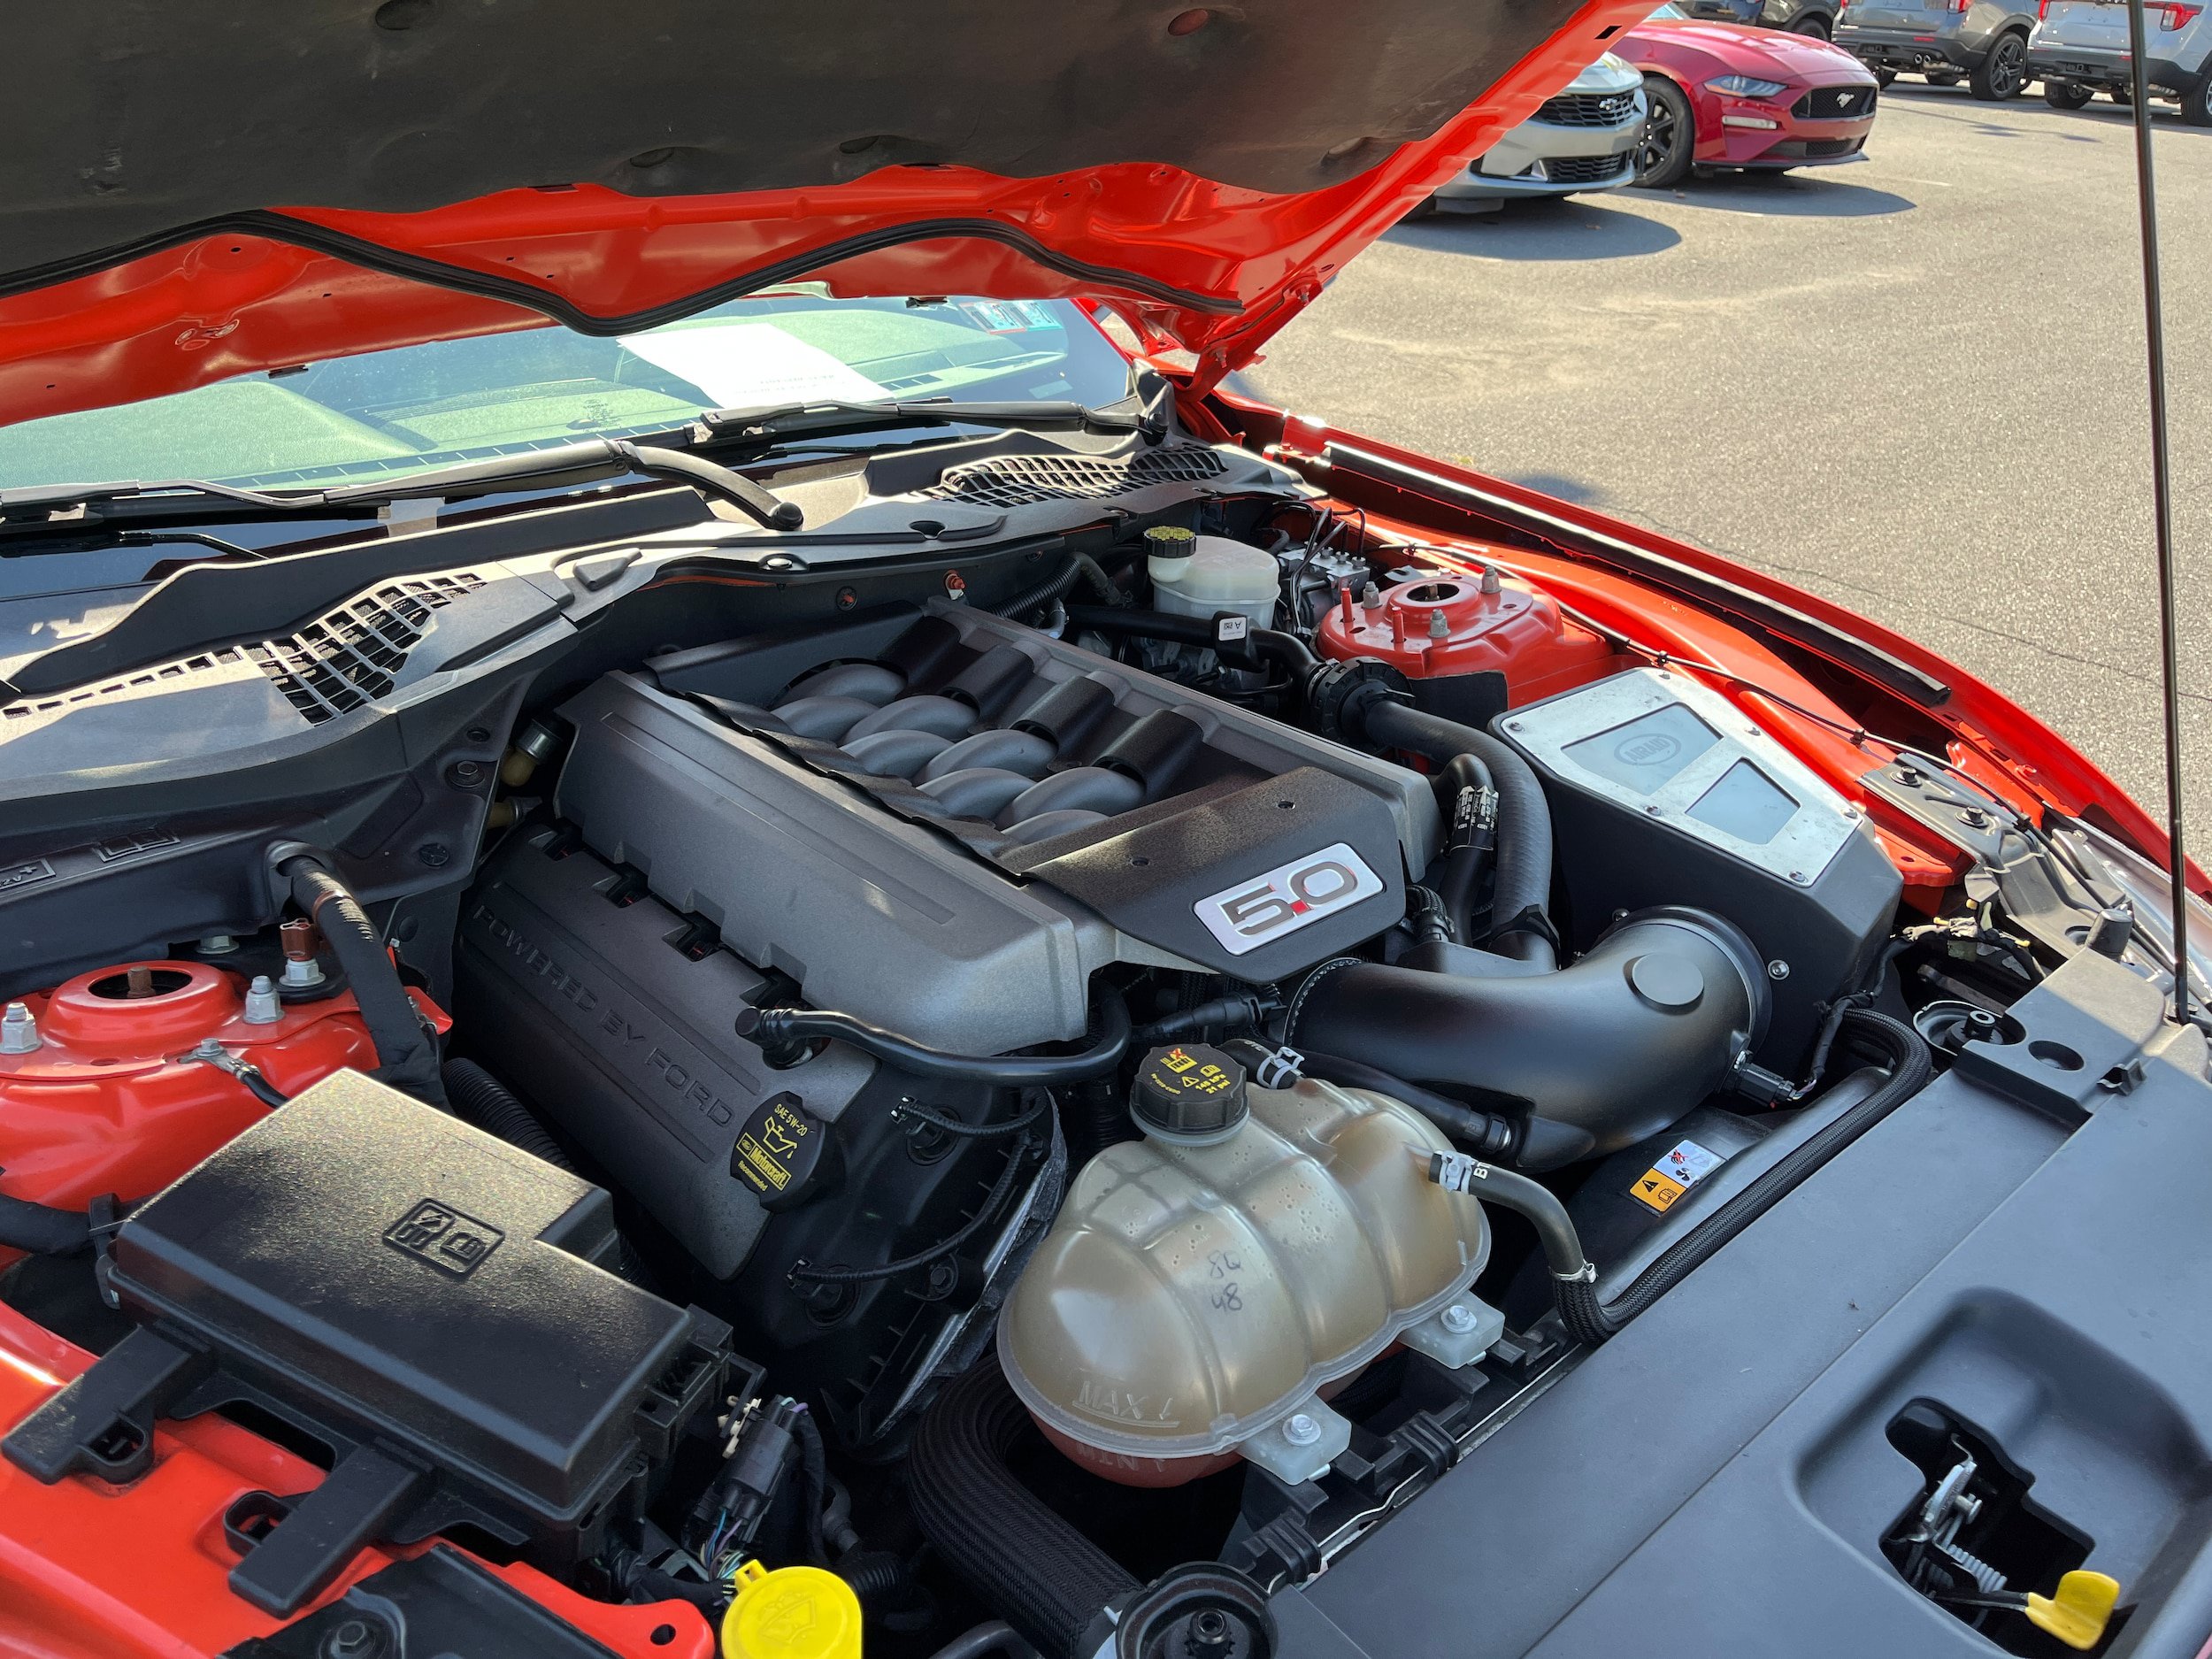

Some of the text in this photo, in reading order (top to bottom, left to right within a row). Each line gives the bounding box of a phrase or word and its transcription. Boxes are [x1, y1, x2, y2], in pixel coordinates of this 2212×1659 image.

[1216, 858, 1360, 938] 5.0
[472, 904, 734, 1128] POWERED BY FORD
[1205, 1086, 1218, 1094] 21
[774, 1103, 808, 1137] SAE 5W-20
[749, 1147, 787, 1187] Motorcraft
[1079, 1380, 1148, 1420] MAX
